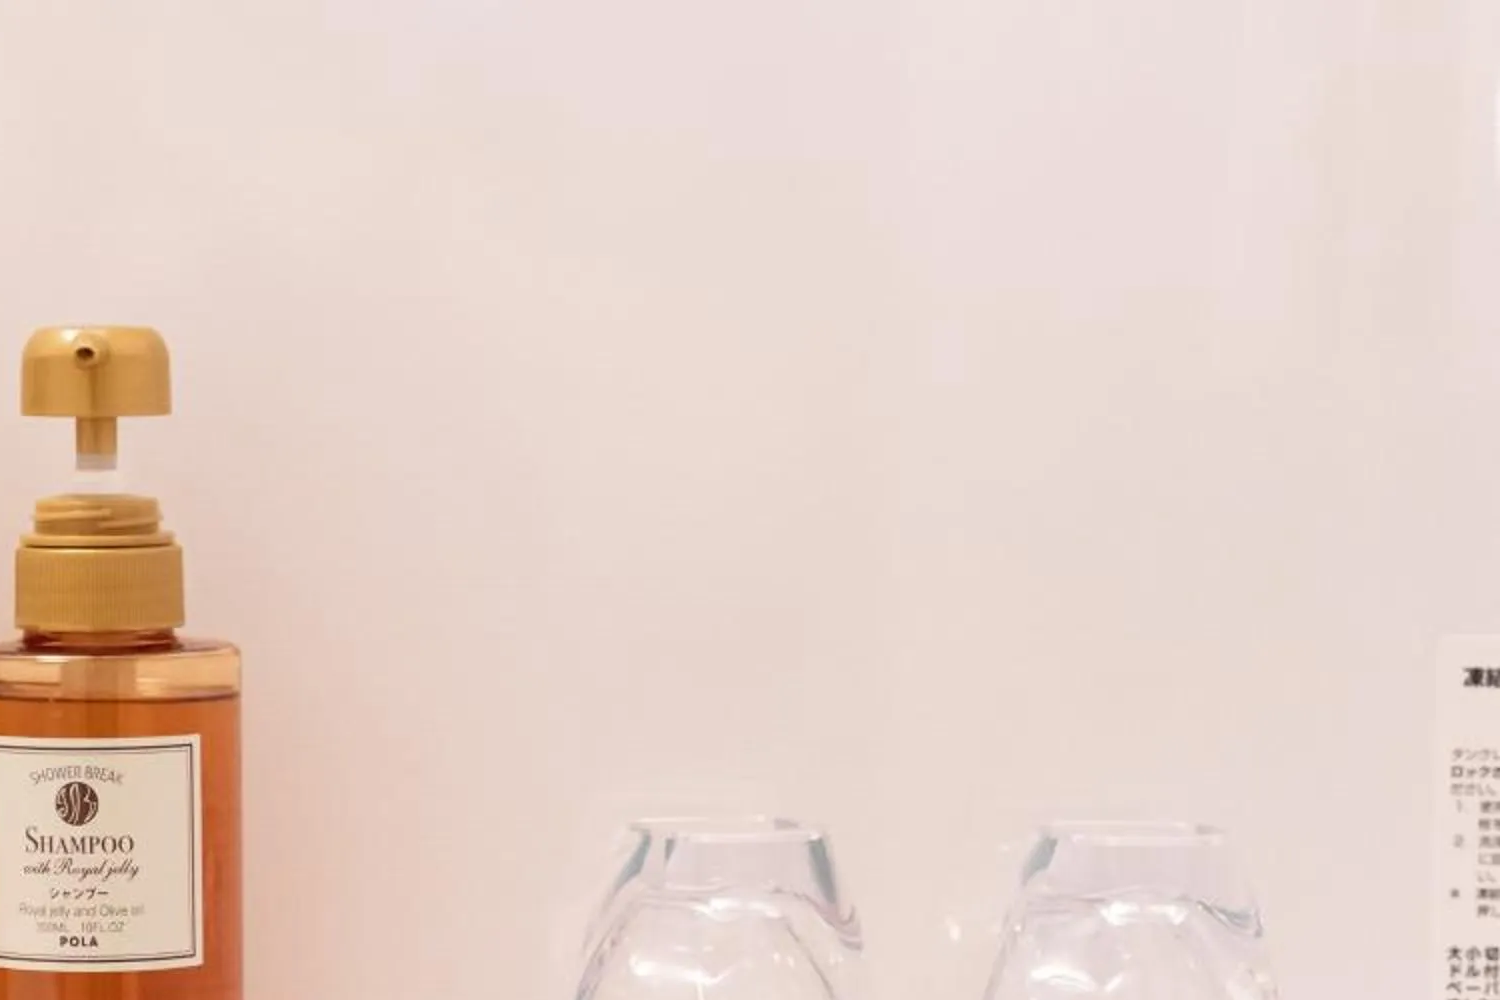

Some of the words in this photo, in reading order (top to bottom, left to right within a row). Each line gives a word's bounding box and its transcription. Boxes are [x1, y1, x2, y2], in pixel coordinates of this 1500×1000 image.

[29, 765, 81, 785] SHOWER
[84, 765, 124, 785] BREAK
[24, 826, 135, 855] SHAMPOO
[23, 860, 50, 875] with
[52, 858, 105, 880] Royal
[103, 859, 139, 881] jelly
[59, 936, 98, 947] POLA
